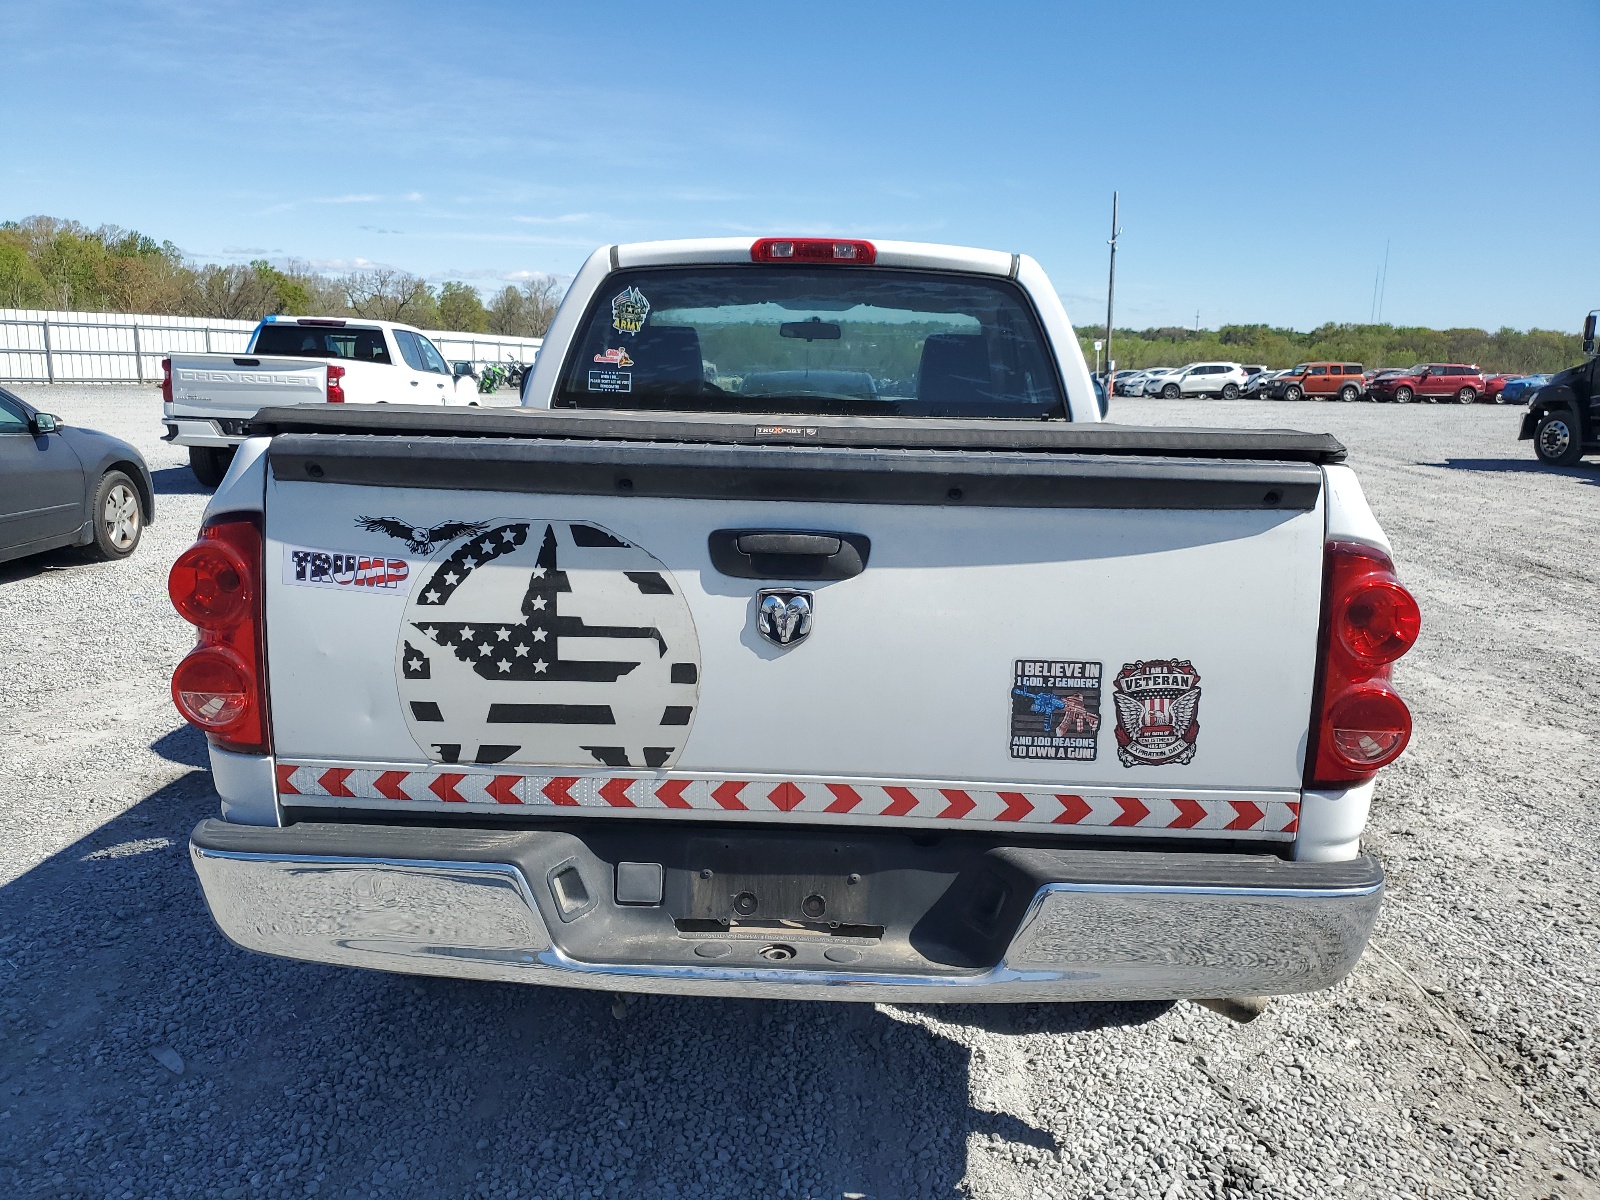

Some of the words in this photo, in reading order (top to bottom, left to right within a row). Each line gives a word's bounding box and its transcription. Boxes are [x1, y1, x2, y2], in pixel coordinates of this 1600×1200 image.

[614, 318, 640, 330] ARMY
[180, 370, 315, 386] CHEVROLET
[292, 551, 409, 588] TRUMP
[1017, 662, 1022, 675] I
[1024, 662, 1082, 677] BELIEVE
[1084, 663, 1100, 677] IN
[1145, 667, 1149, 675] I
[1150, 666, 1162, 674] AM
[1016, 677, 1022, 686] 1
[1047, 677, 1054, 687] 2
[1055, 678, 1099, 688] GENDERS
[1125, 675, 1189, 690] VETERAN
[1012, 736, 1032, 745] AND
[1033, 736, 1051, 746] 100
[1052, 737, 1095, 748] REASONS
[1012, 746, 1027, 757] TO
[1028, 746, 1056, 757] OWN
[1057, 747, 1065, 758] A
[1067, 748, 1094, 759] GUN!
[1130, 743, 1166, 757] EXPIRATION
[1168, 742, 1184, 754] DATE
